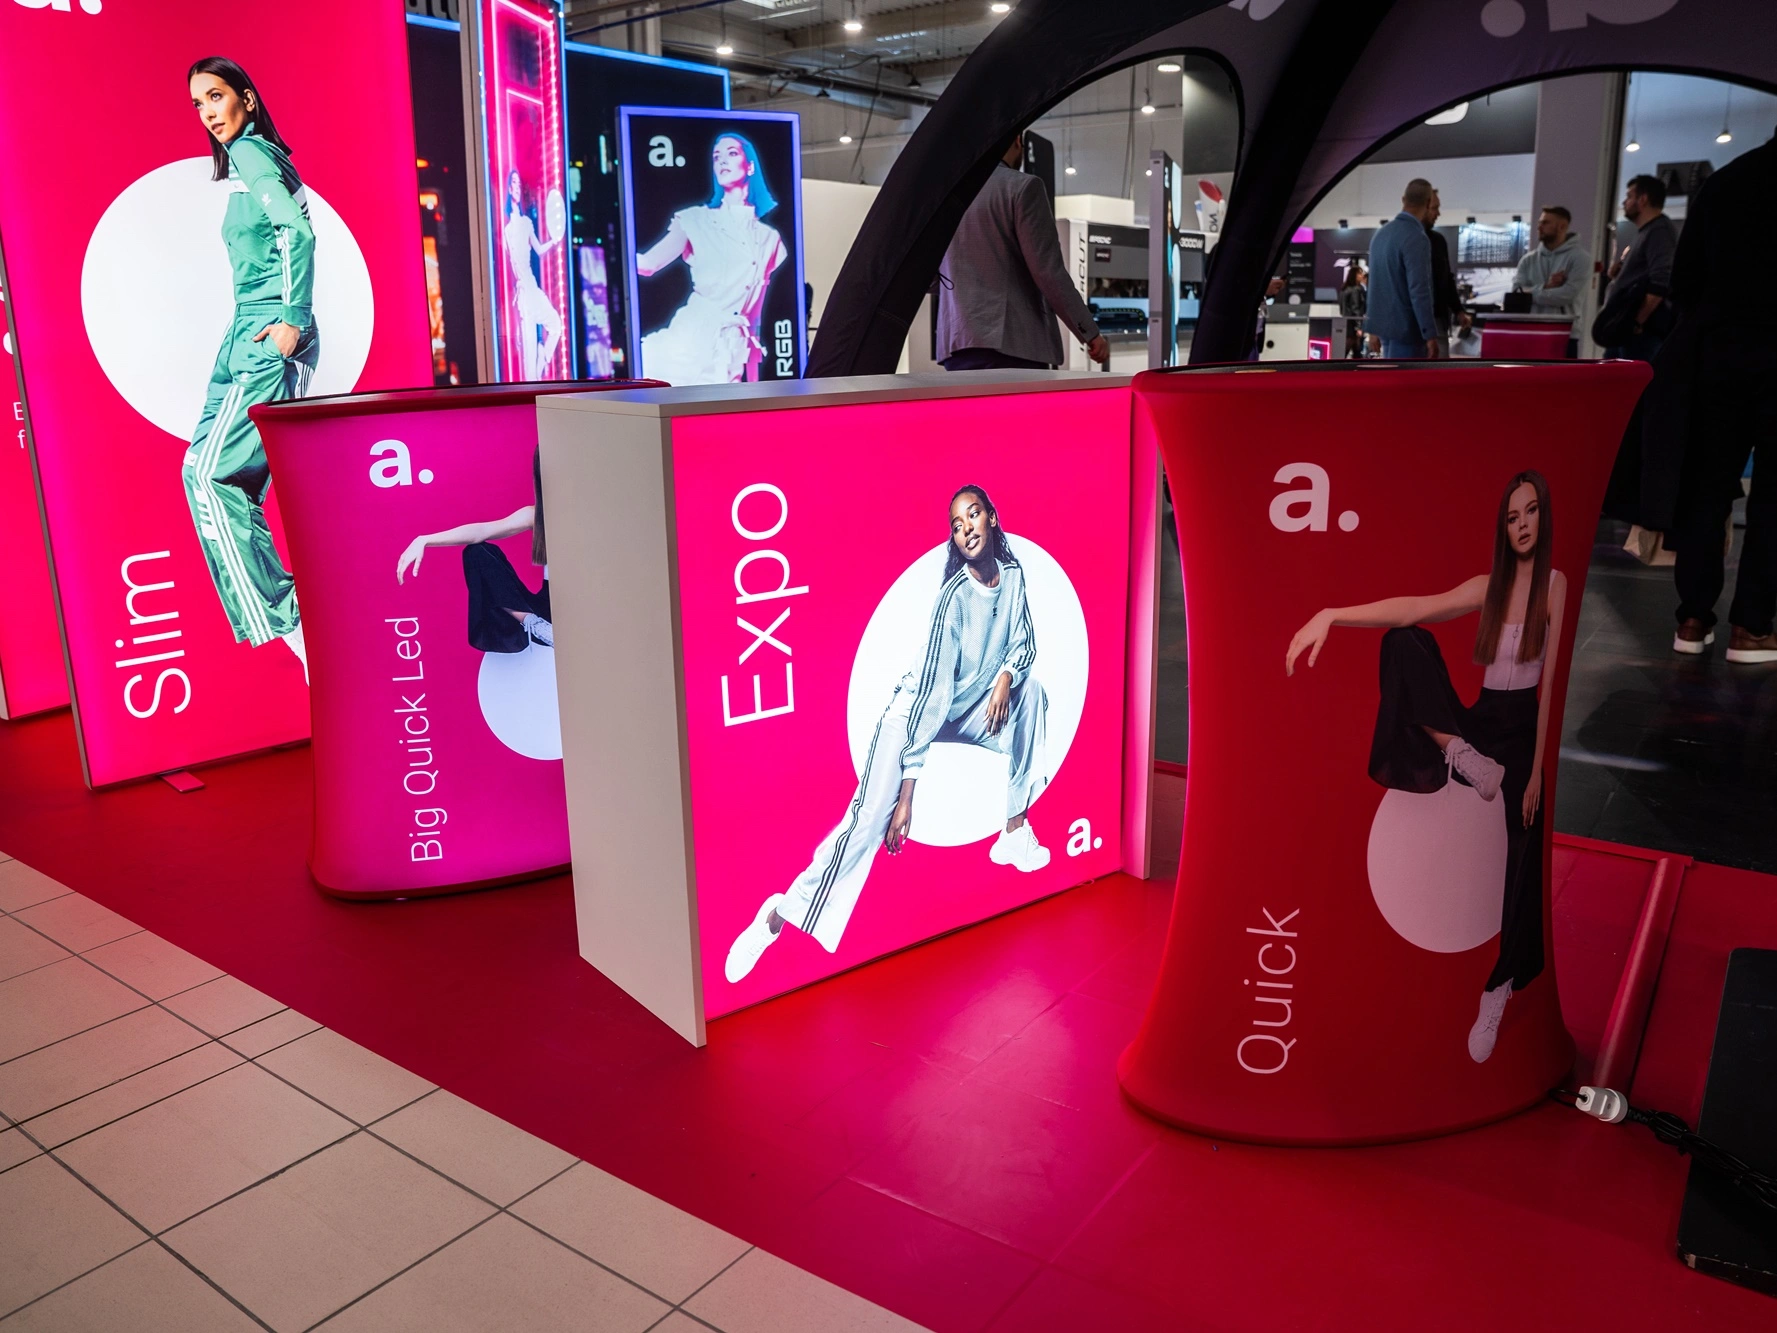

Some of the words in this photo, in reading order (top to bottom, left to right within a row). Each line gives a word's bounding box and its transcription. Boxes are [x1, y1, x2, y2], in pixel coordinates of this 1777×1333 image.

[649, 136, 686, 168] a.
[775, 319, 793, 377] RGB
[370, 439, 434, 488] a.
[1268, 462, 1360, 533] a.
[115, 550, 191, 719] Slim
[721, 482, 809, 727] Expo
[385, 616, 424, 682] Led
[393, 693, 439, 795] Quick
[409, 807, 448, 862] Big
[1066, 817, 1103, 857] a.
[1236, 906, 1300, 1075] Quick
